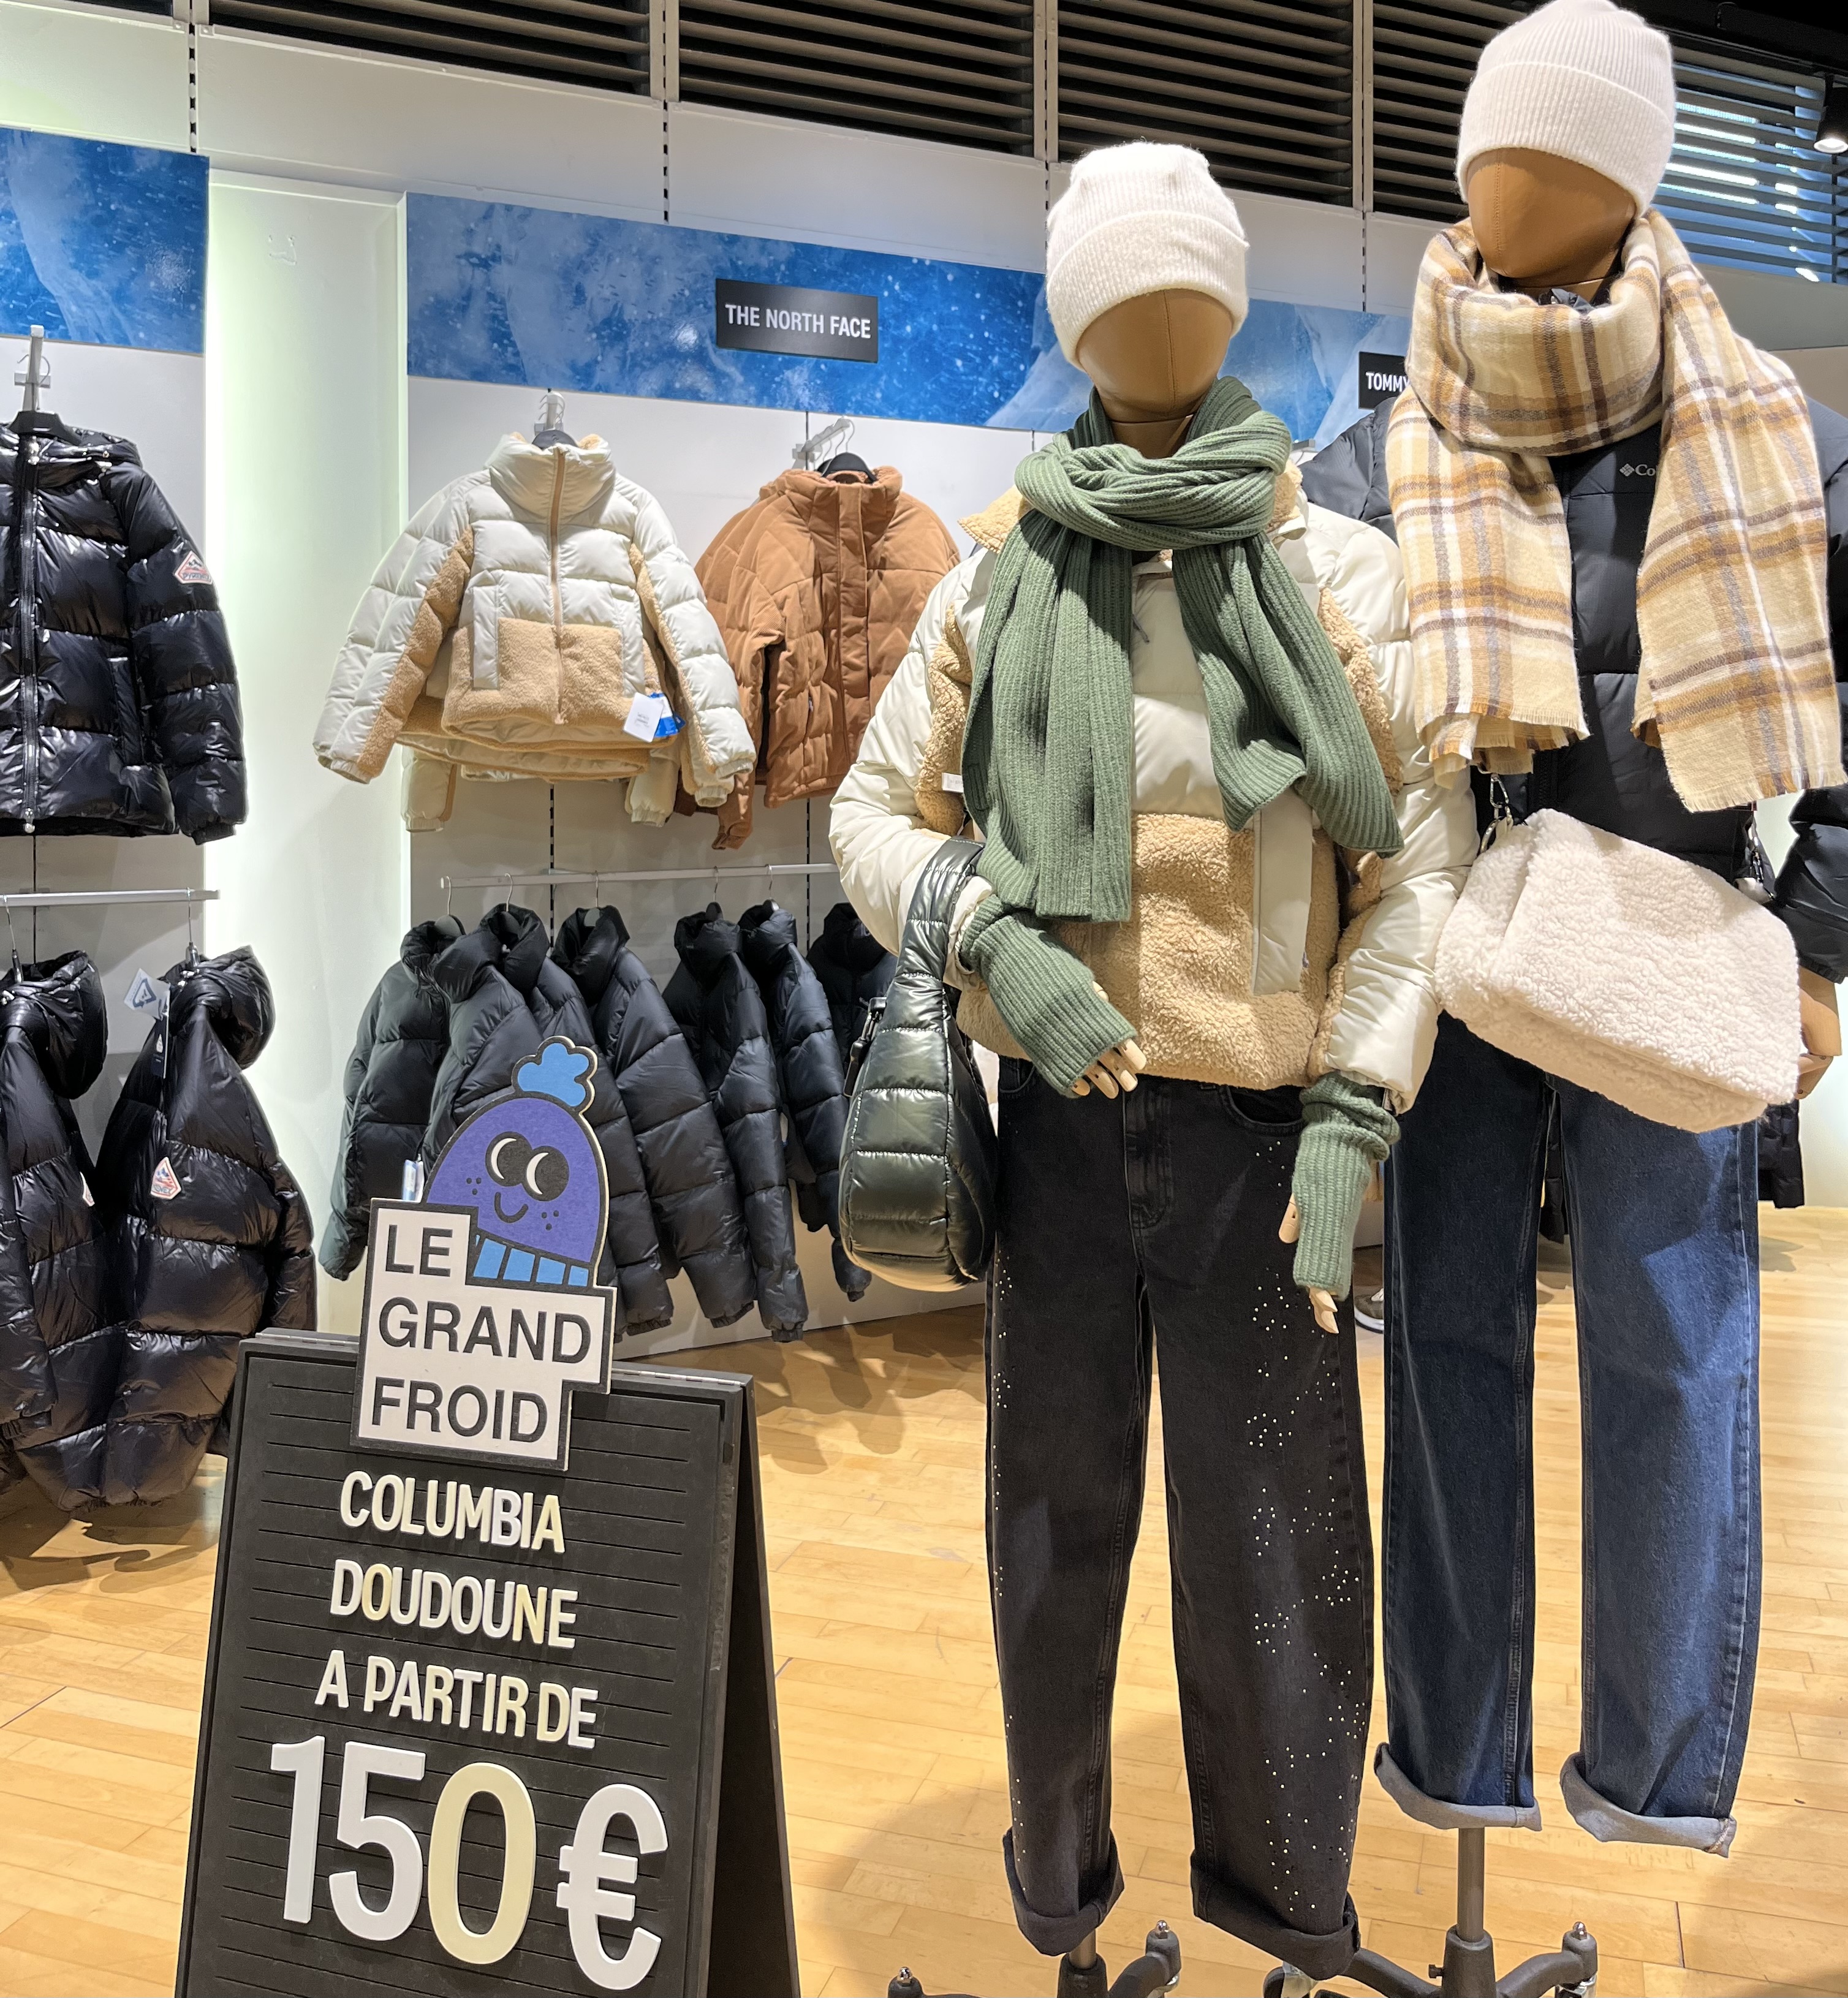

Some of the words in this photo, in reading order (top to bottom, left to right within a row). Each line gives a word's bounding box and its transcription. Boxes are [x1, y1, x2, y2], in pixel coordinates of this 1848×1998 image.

[725, 304, 760, 327] THE
[766, 308, 824, 334] NORTH
[830, 316, 871, 338] FACE
[385, 1224, 453, 1277] LE
[379, 1296, 591, 1364] GRAND
[371, 1376, 547, 1443] FROID
[340, 1471, 565, 1553] COLUMBIA
[330, 1559, 578, 1648] DOUDOUNE
[315, 1649, 349, 1708] A
[363, 1656, 528, 1738] PARTIR
[536, 1682, 599, 1749] DE
